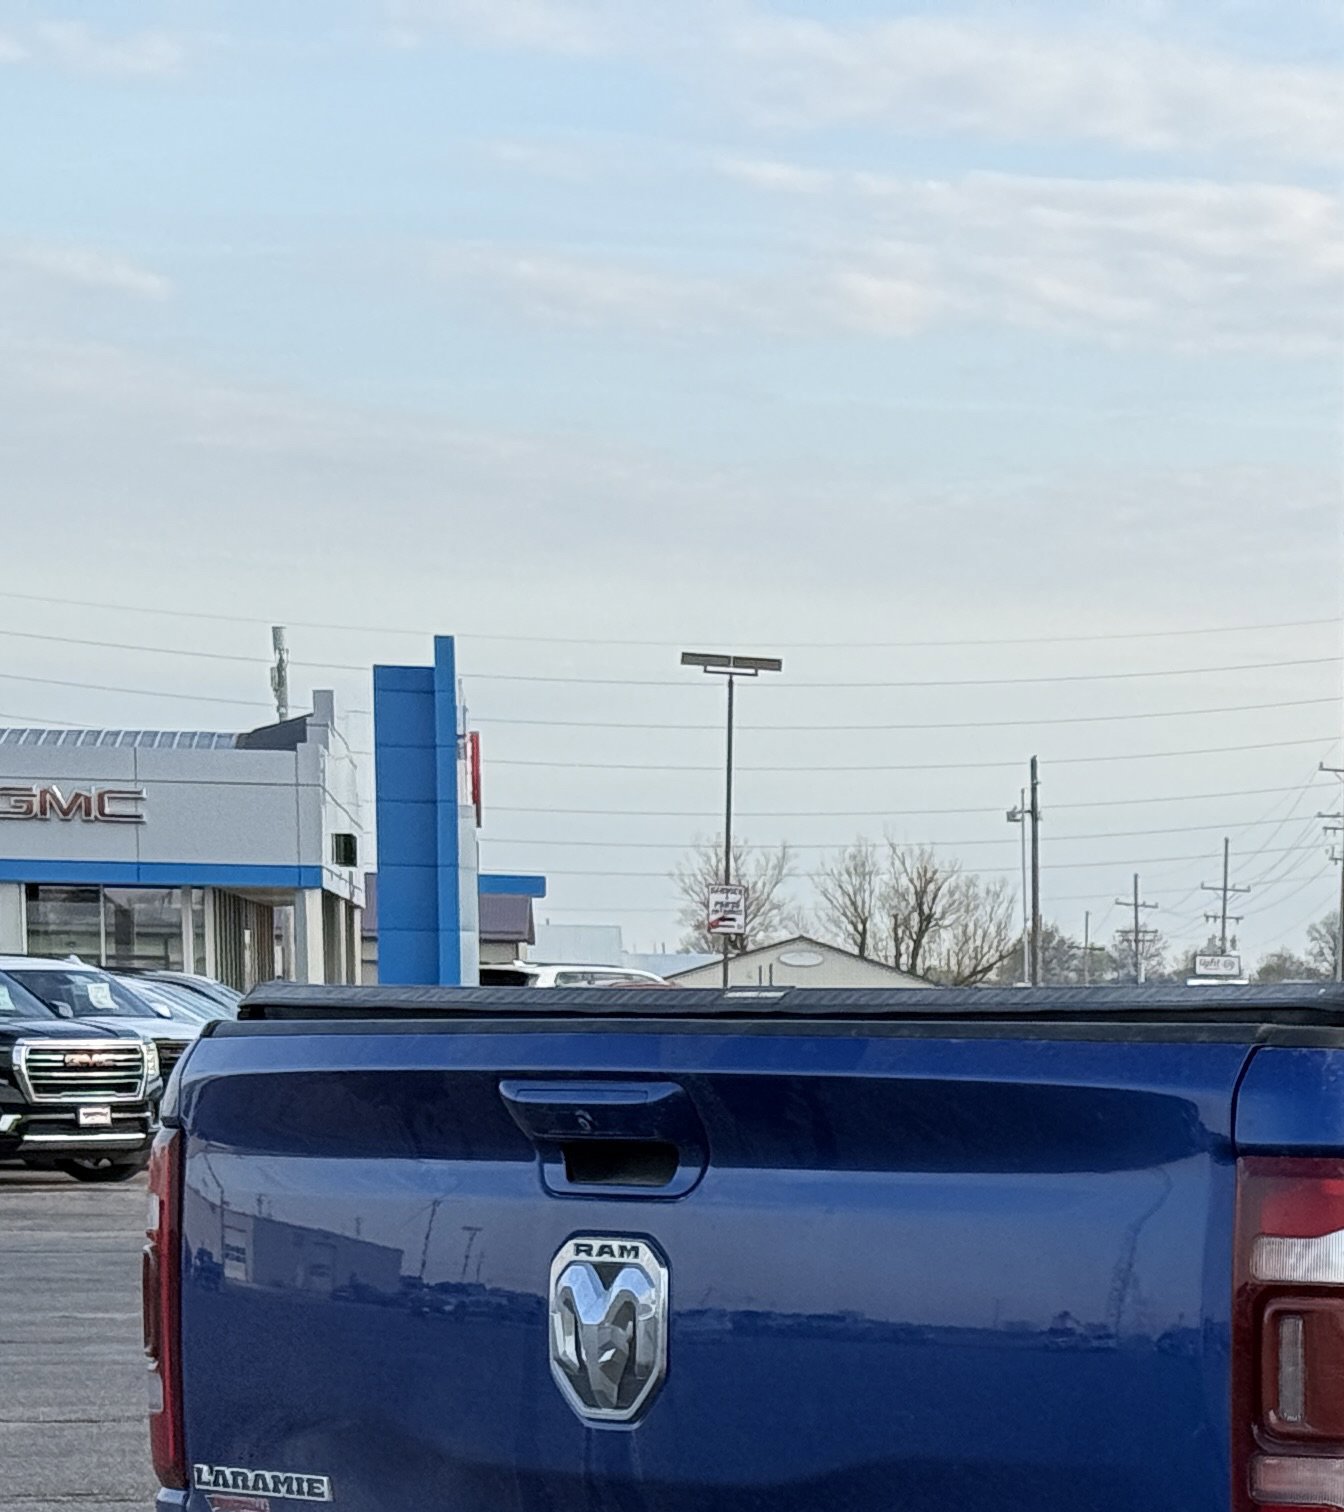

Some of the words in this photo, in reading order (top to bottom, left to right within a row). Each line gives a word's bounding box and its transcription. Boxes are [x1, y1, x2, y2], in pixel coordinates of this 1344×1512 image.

[0, 784, 147, 823] GMC
[573, 1243, 640, 1259] RAM
[194, 1464, 332, 1501] LARAMIE
